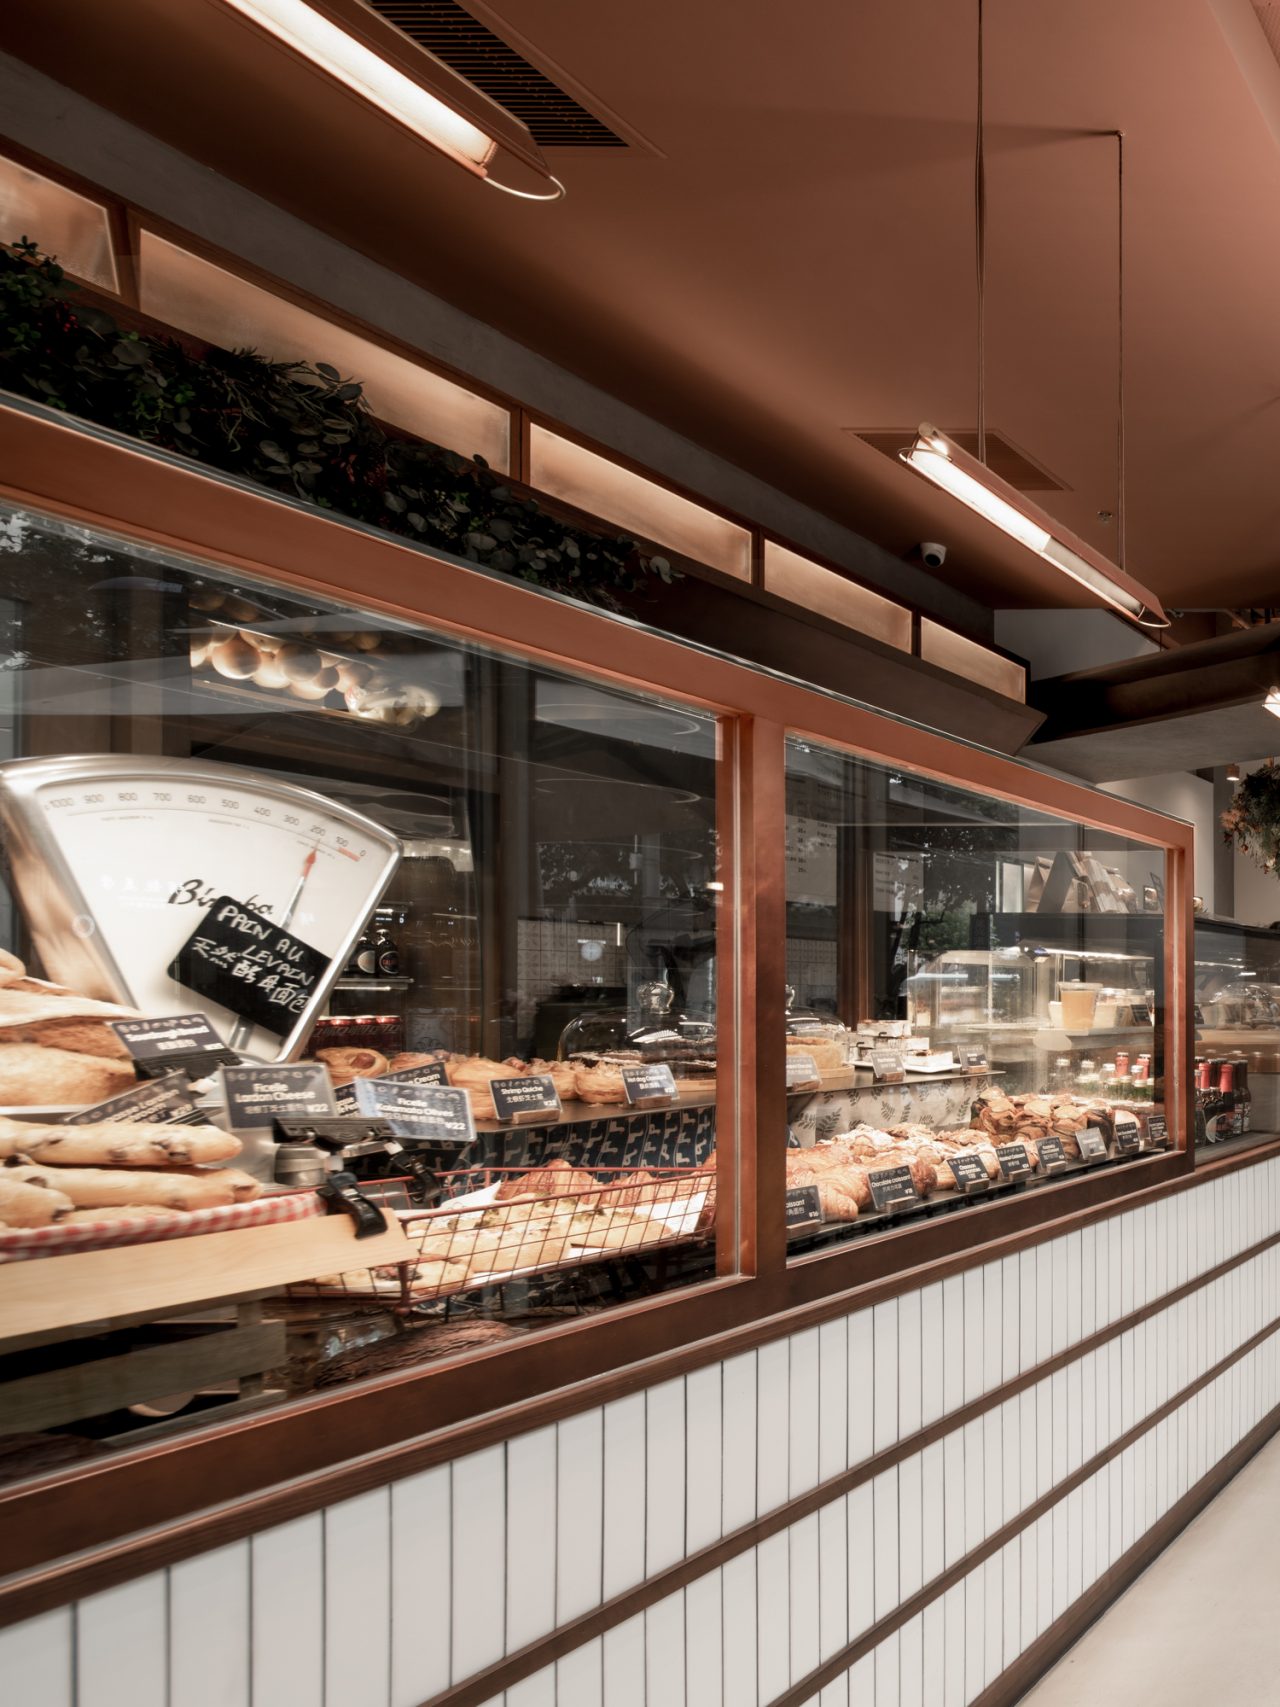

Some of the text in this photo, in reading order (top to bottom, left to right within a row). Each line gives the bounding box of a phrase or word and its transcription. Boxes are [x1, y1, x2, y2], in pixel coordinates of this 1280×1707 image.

[118, 793, 138, 801] 800
[152, 793, 172, 802] 700
[221, 799, 240, 810] 500
[254, 806, 272, 817] 400
[284, 814, 300, 827] 300
[310, 825, 326, 837] 200
[336, 836, 349, 848] 100
[217, 904, 305, 963] PAIN AU
[240, 944, 315, 987] LEVAIN
[253, 1083, 289, 1093] Ficelle
[501, 1087, 522, 1095] Shrimp
[273, 1091, 316, 1101] Cheese
[397, 1097, 428, 1107] Ficelle
[871, 1178, 893, 1188] Chocolate
